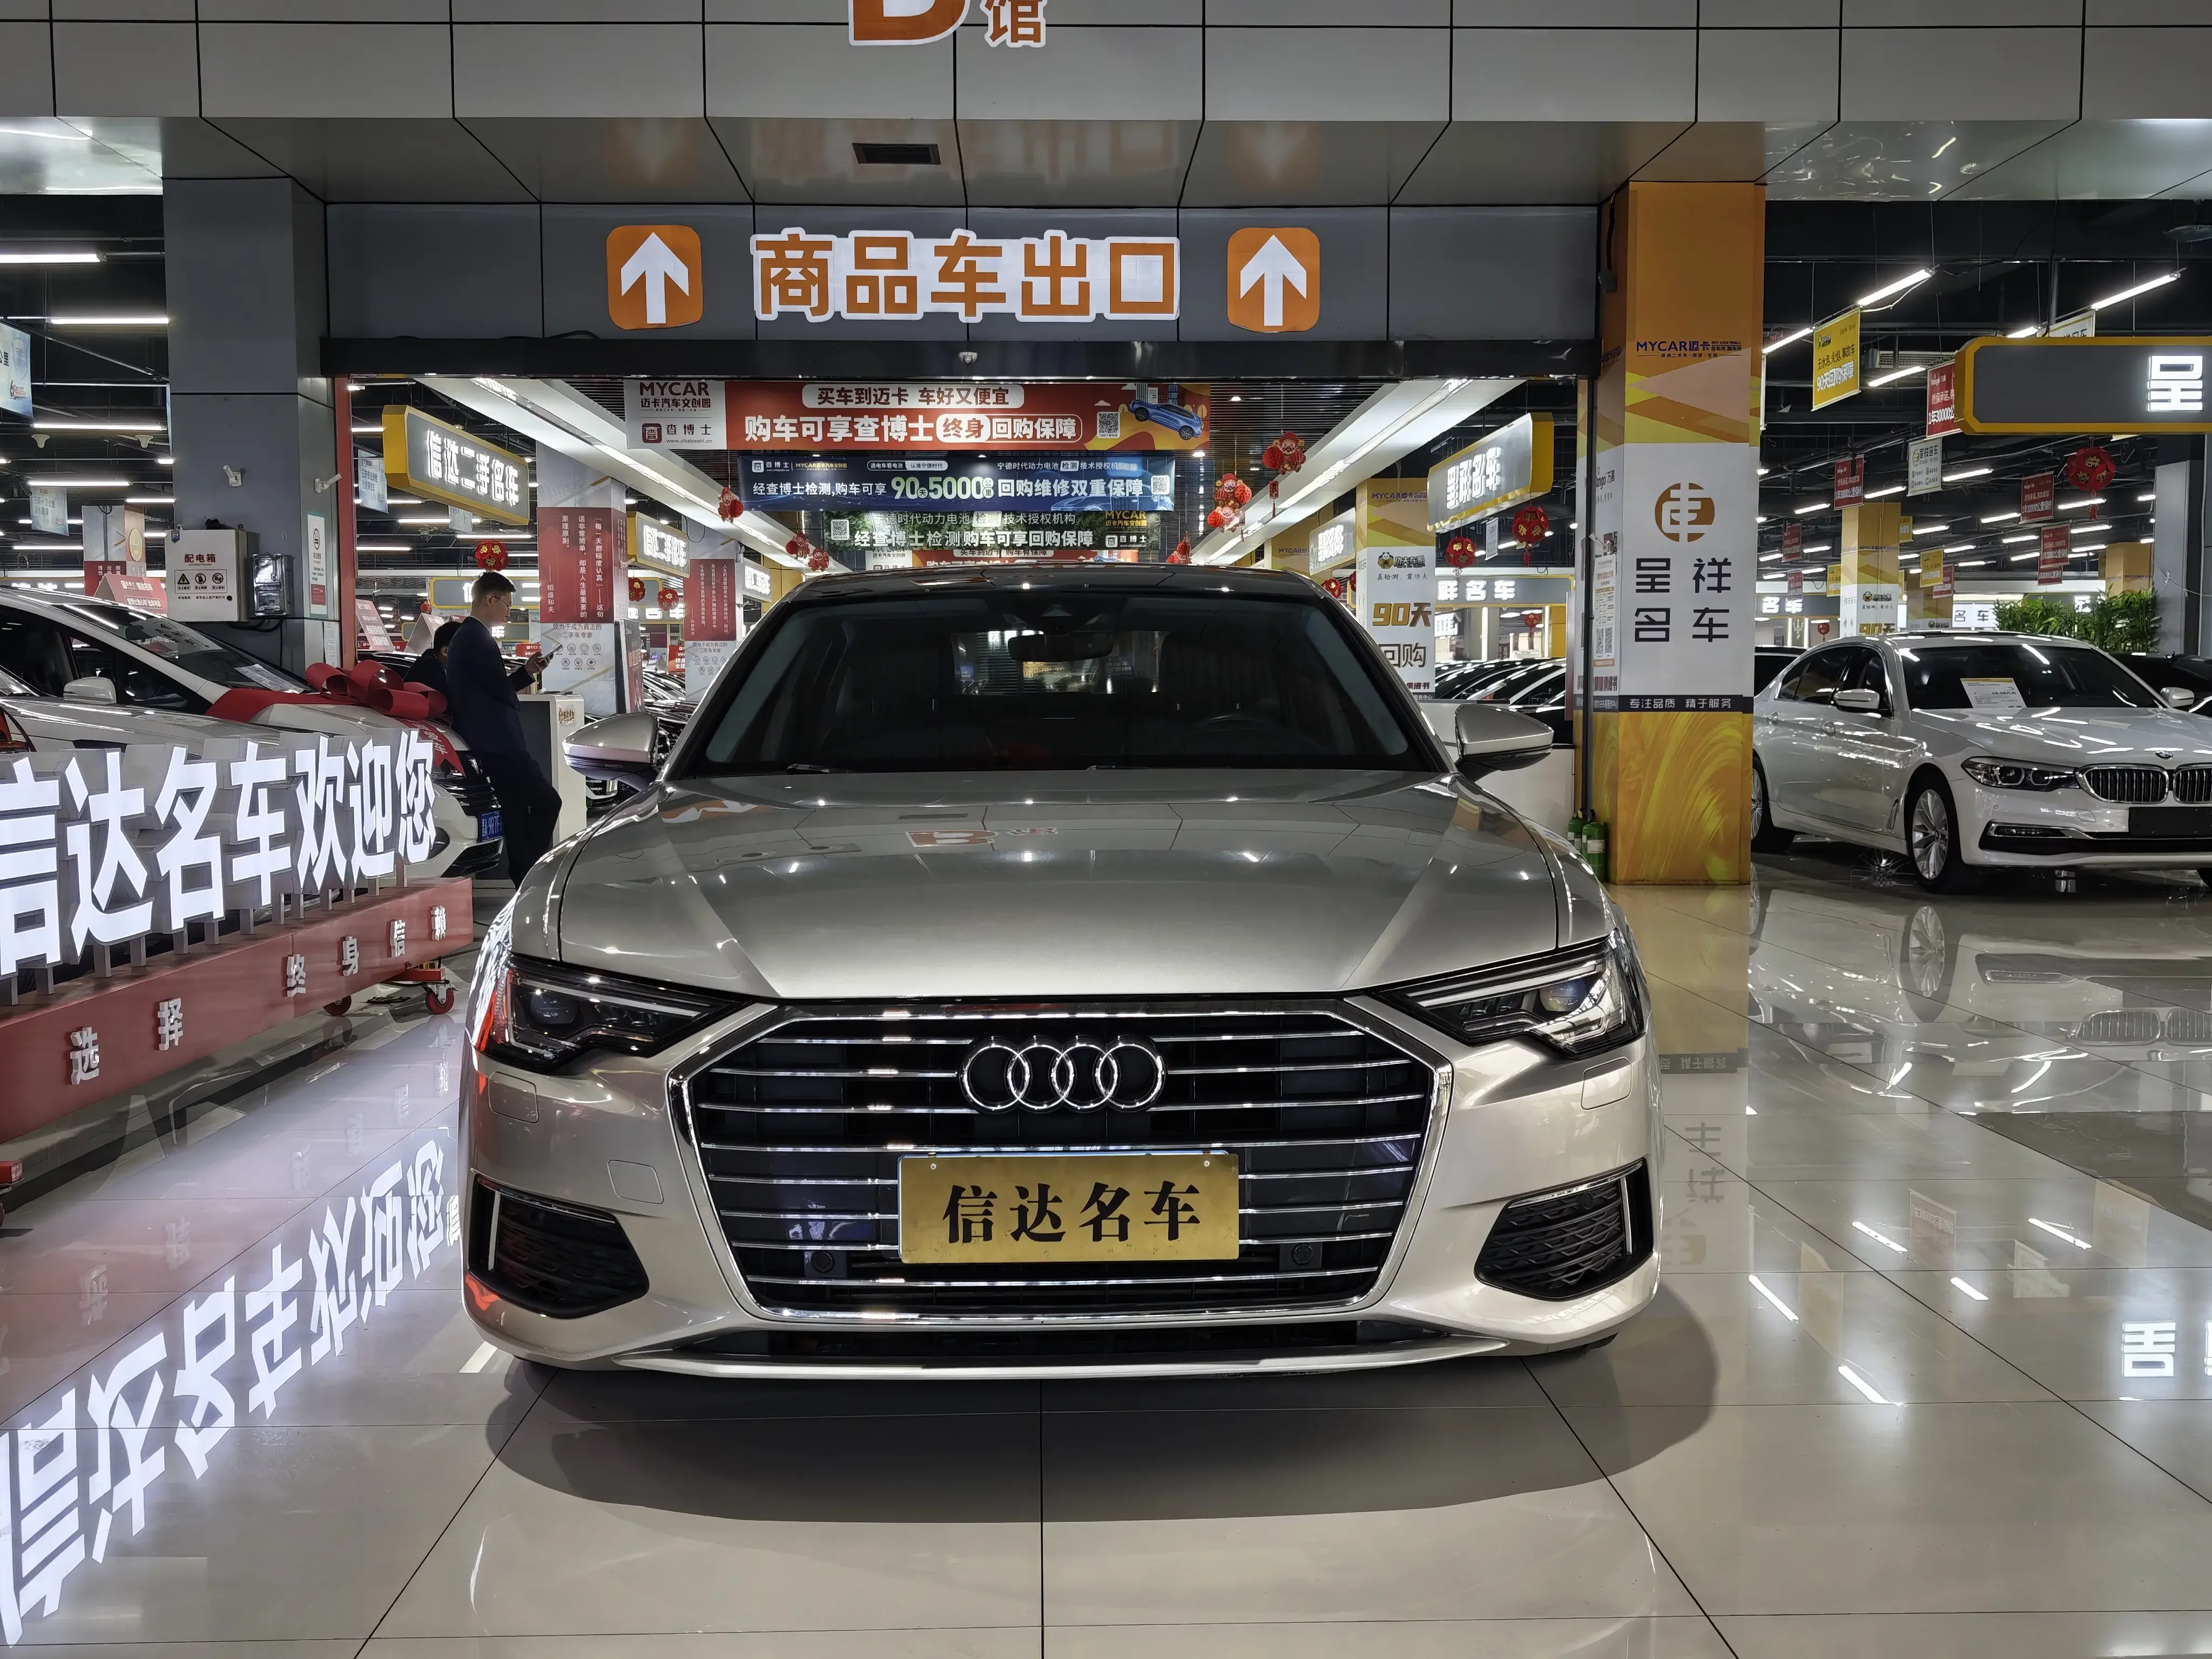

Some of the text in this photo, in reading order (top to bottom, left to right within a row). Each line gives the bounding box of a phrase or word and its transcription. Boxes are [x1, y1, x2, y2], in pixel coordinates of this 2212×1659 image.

[753, 233, 1176, 318] 商品车出口
[639, 382, 710, 396] MYCAR
[2147, 354, 2204, 412] 呈
[640, 398, 711, 408] 迈卡汽车文创园
[817, 387, 1009, 406] 买车到迈卡 车好又便宜
[666, 424, 712, 435] 查博士
[426, 429, 520, 508] 信达二手名车
[997, 478, 1143, 497] 回购维修双重保障
[1105, 510, 1147, 520] MYCAR
[184, 554, 216, 563] 配电箱
[1372, 602, 1432, 628] 90天
[1634, 607, 1730, 643] 名车
[1378, 643, 1427, 668] 回购
[1629, 698, 1676, 709] 专注品质
[1685, 698, 1731, 709] 精于服务
[0, 729, 436, 974] 信达名车欢迎您
[942, 1181, 1201, 1244] 信达名车
